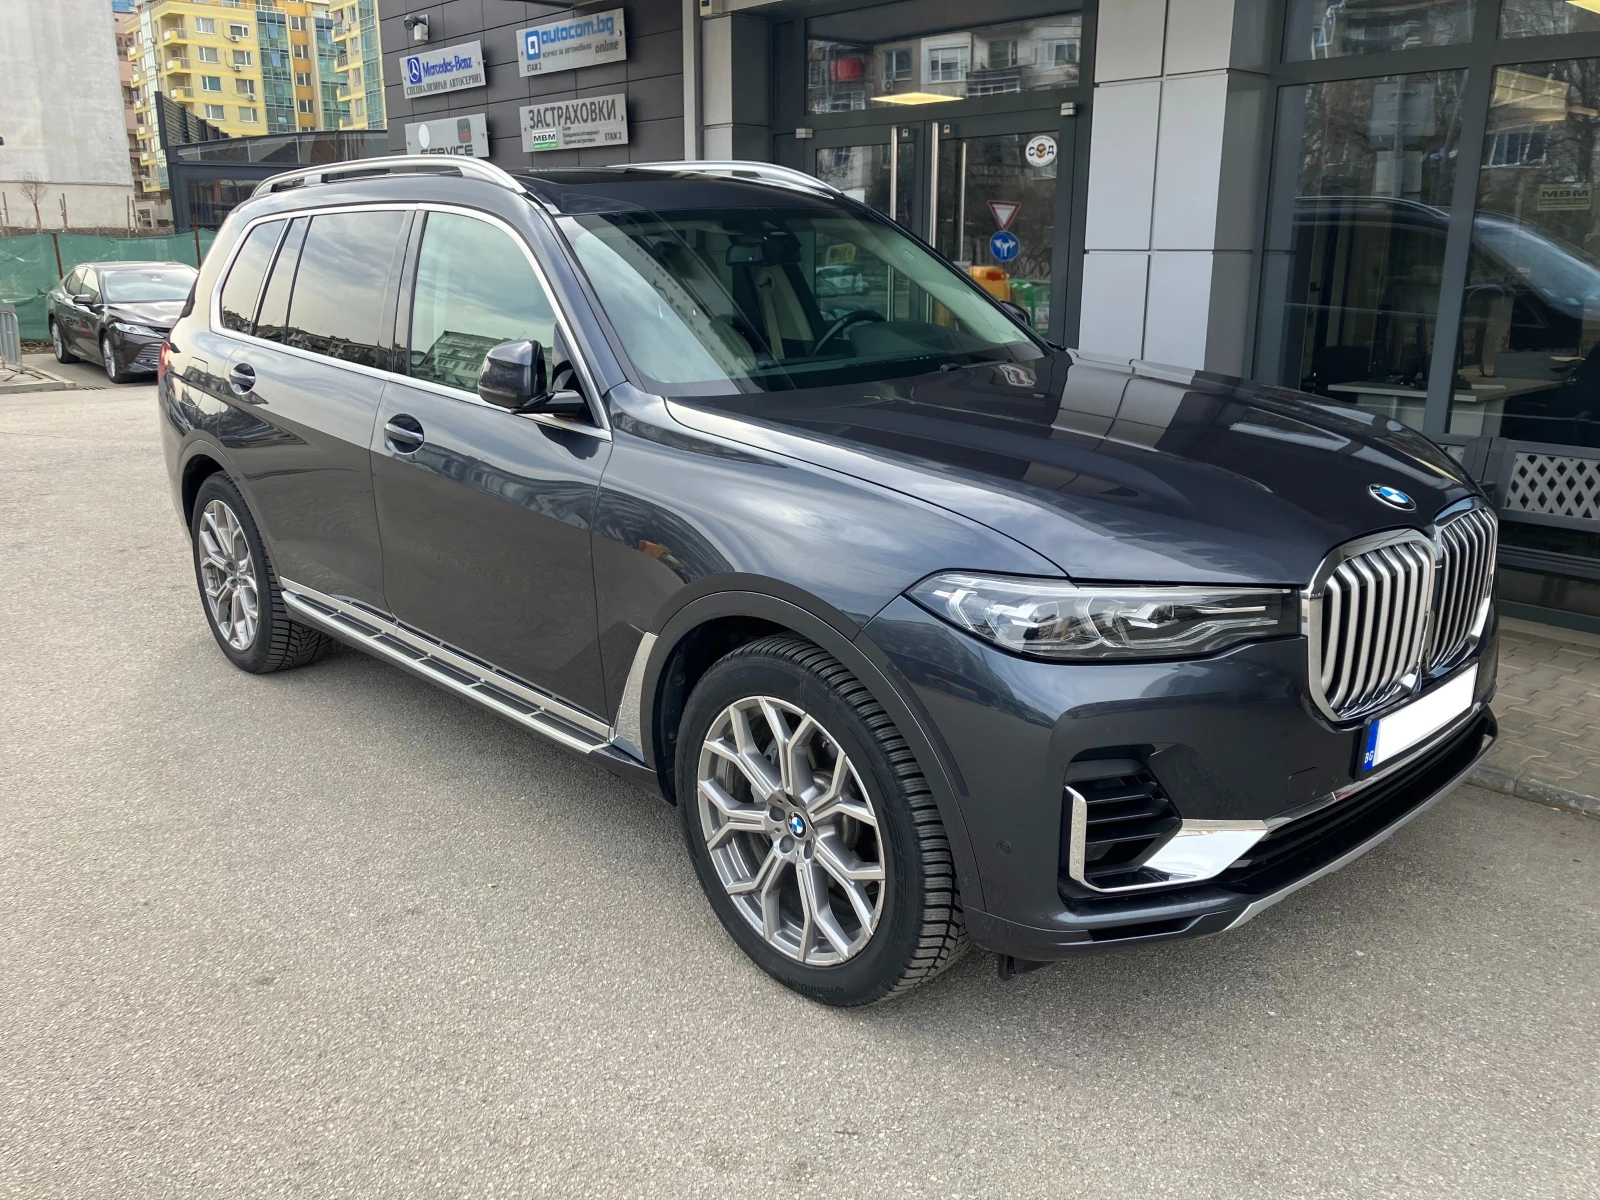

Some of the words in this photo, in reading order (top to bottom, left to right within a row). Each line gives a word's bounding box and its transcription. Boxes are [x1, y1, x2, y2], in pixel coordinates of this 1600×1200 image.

[541, 15, 615, 44] autocom.bg
[595, 40, 619, 54] online
[422, 55, 473, 78] Mercedes-Benz
[526, 63, 539, 72] ЕТАЖ
[406, 80, 448, 96] СПЕЦИАЛИЗИРАН
[449, 73, 482, 88] АВТОСЕРВИЗ
[528, 99, 617, 129] ЗАСТРАХОВКИ
[605, 132, 618, 141] ЕТАЖ
[1364, 750, 1374, 764] BG
